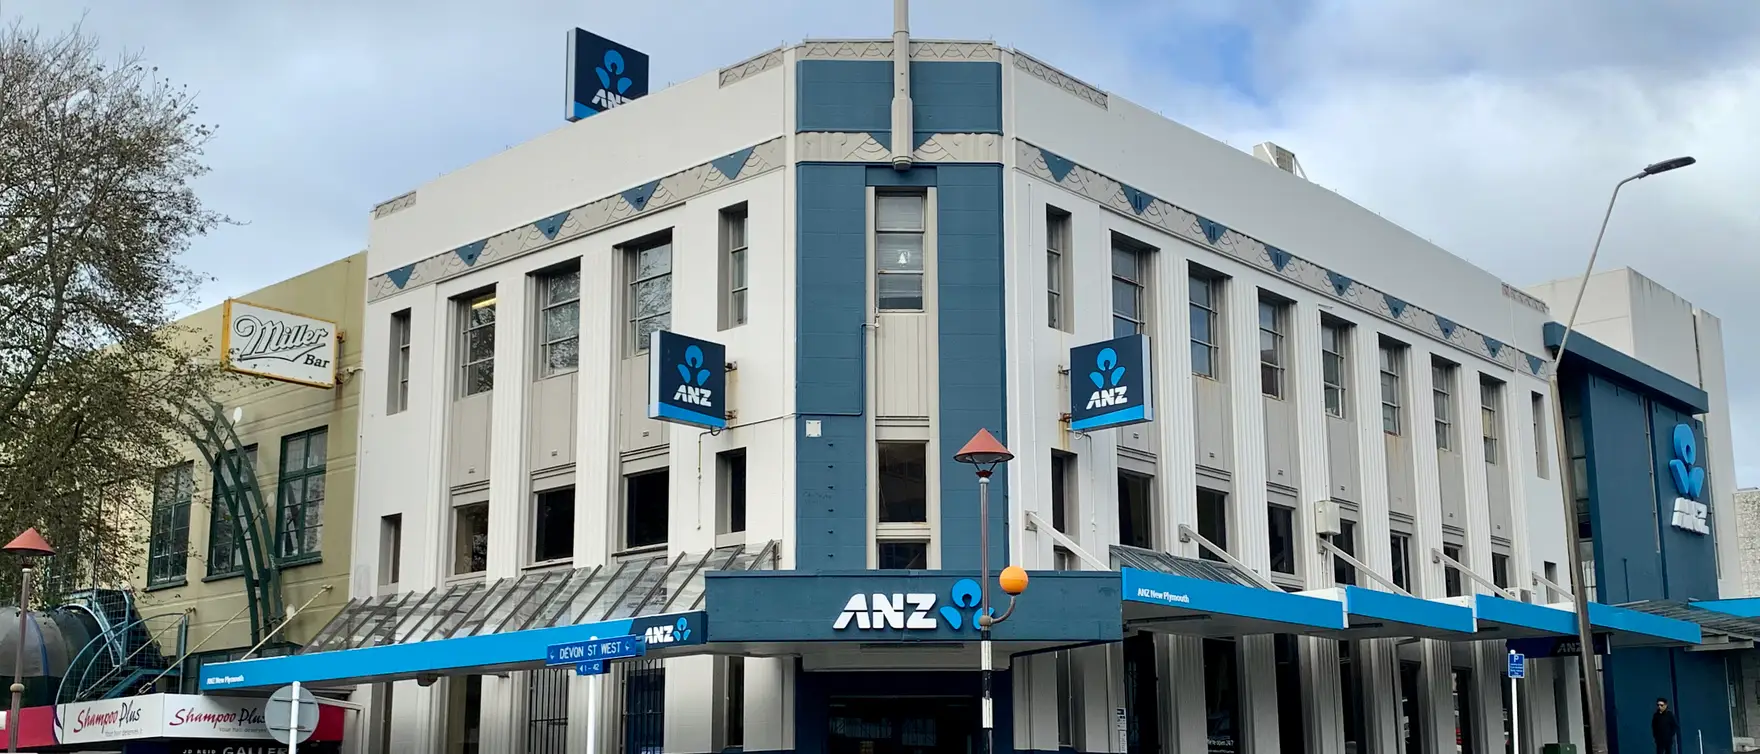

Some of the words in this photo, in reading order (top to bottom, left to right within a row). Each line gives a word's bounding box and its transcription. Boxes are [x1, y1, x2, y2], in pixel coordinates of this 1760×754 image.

[233, 314, 329, 358] Miller
[303, 353, 331, 369] Bar
[673, 384, 712, 407] ANZ
[1086, 385, 1128, 410] ANZ
[1137, 587, 1150, 598] ANZ
[1150, 590, 1163, 600] New
[1163, 591, 1190, 603] Plymouth
[832, 593, 938, 630] ANZ
[644, 625, 674, 645] ANZ
[559, 646, 584, 660] DEVON
[587, 644, 598, 657] ST
[600, 641, 622, 655] WEST
[1513, 654, 1520, 663] P
[73, 707, 118, 734] Shampoo
[118, 699, 142, 728] Plus
[169, 708, 236, 729] Shampoo
